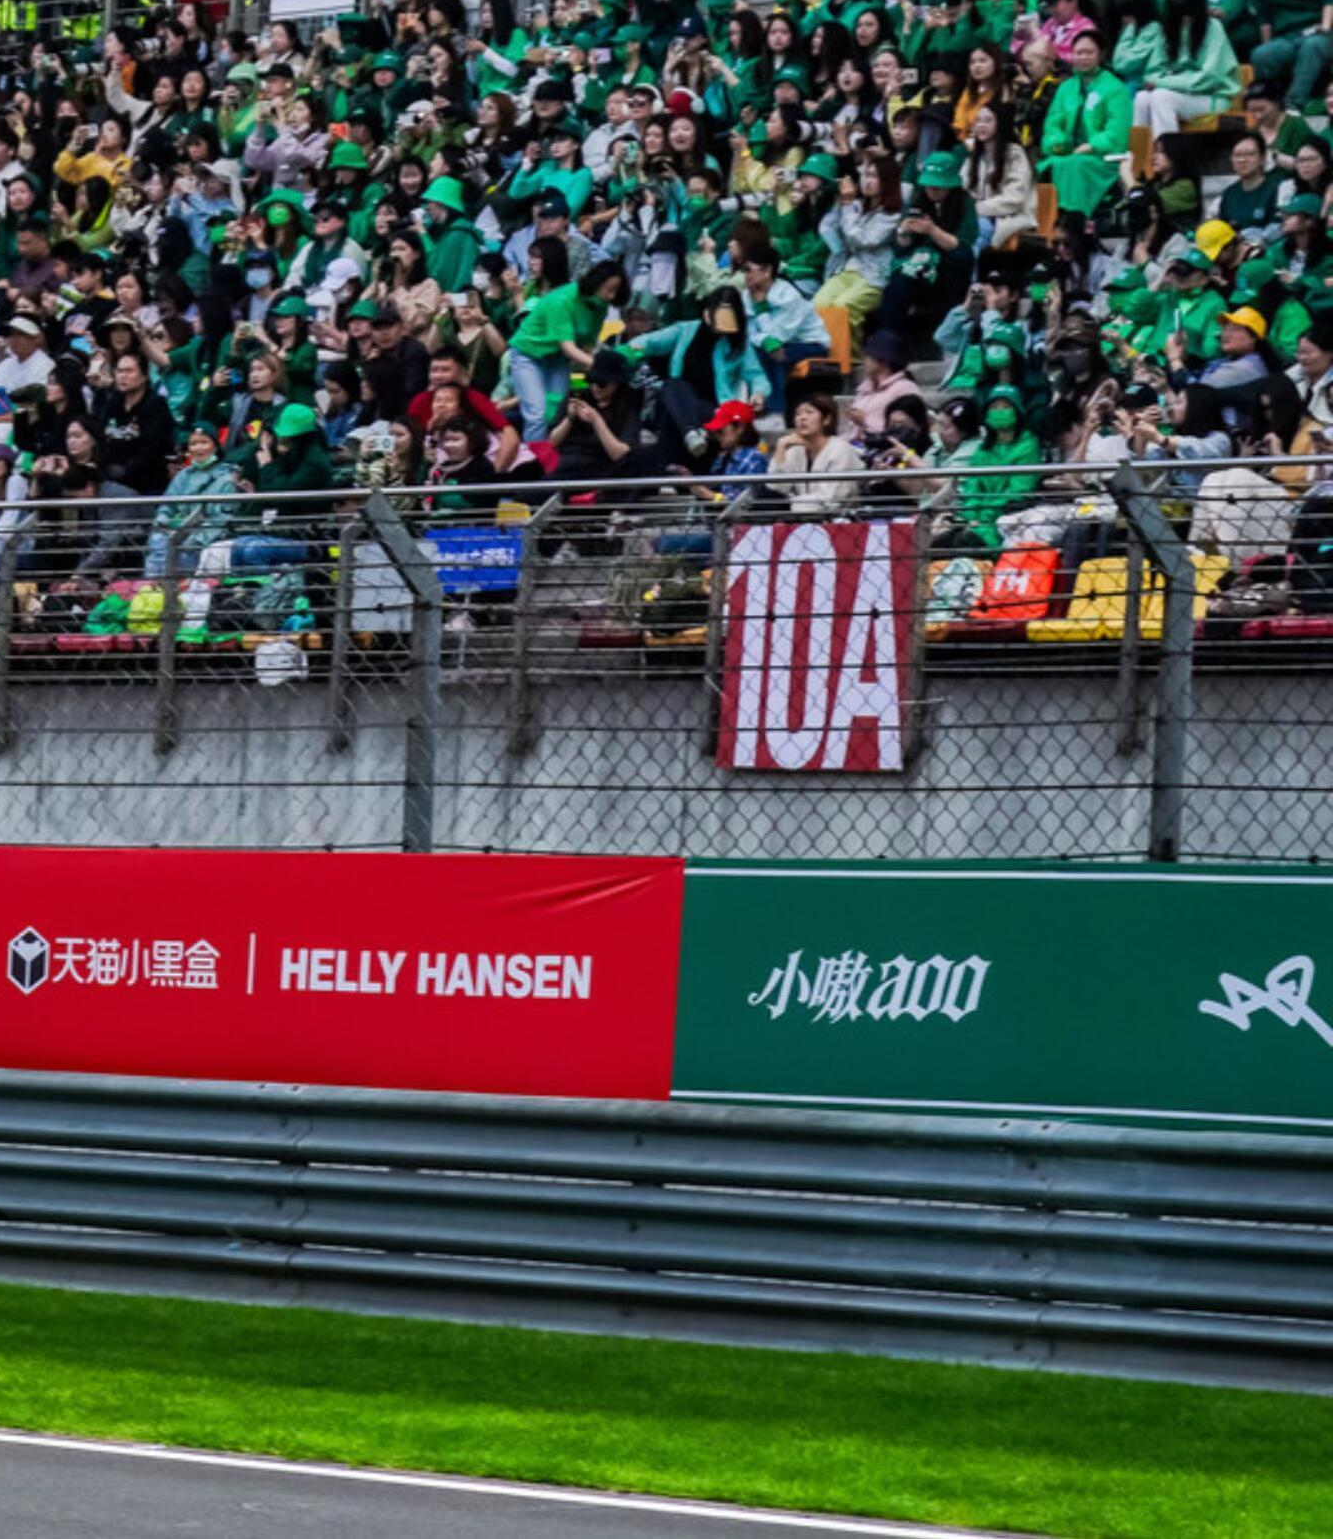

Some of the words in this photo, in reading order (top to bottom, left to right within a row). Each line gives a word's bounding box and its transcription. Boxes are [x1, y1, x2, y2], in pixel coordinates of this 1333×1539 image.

[727, 521, 899, 770] 10A
[53, 936, 219, 989] 天猫小黑盒
[280, 949, 403, 994] HELLY
[416, 950, 591, 998] HANSEN
